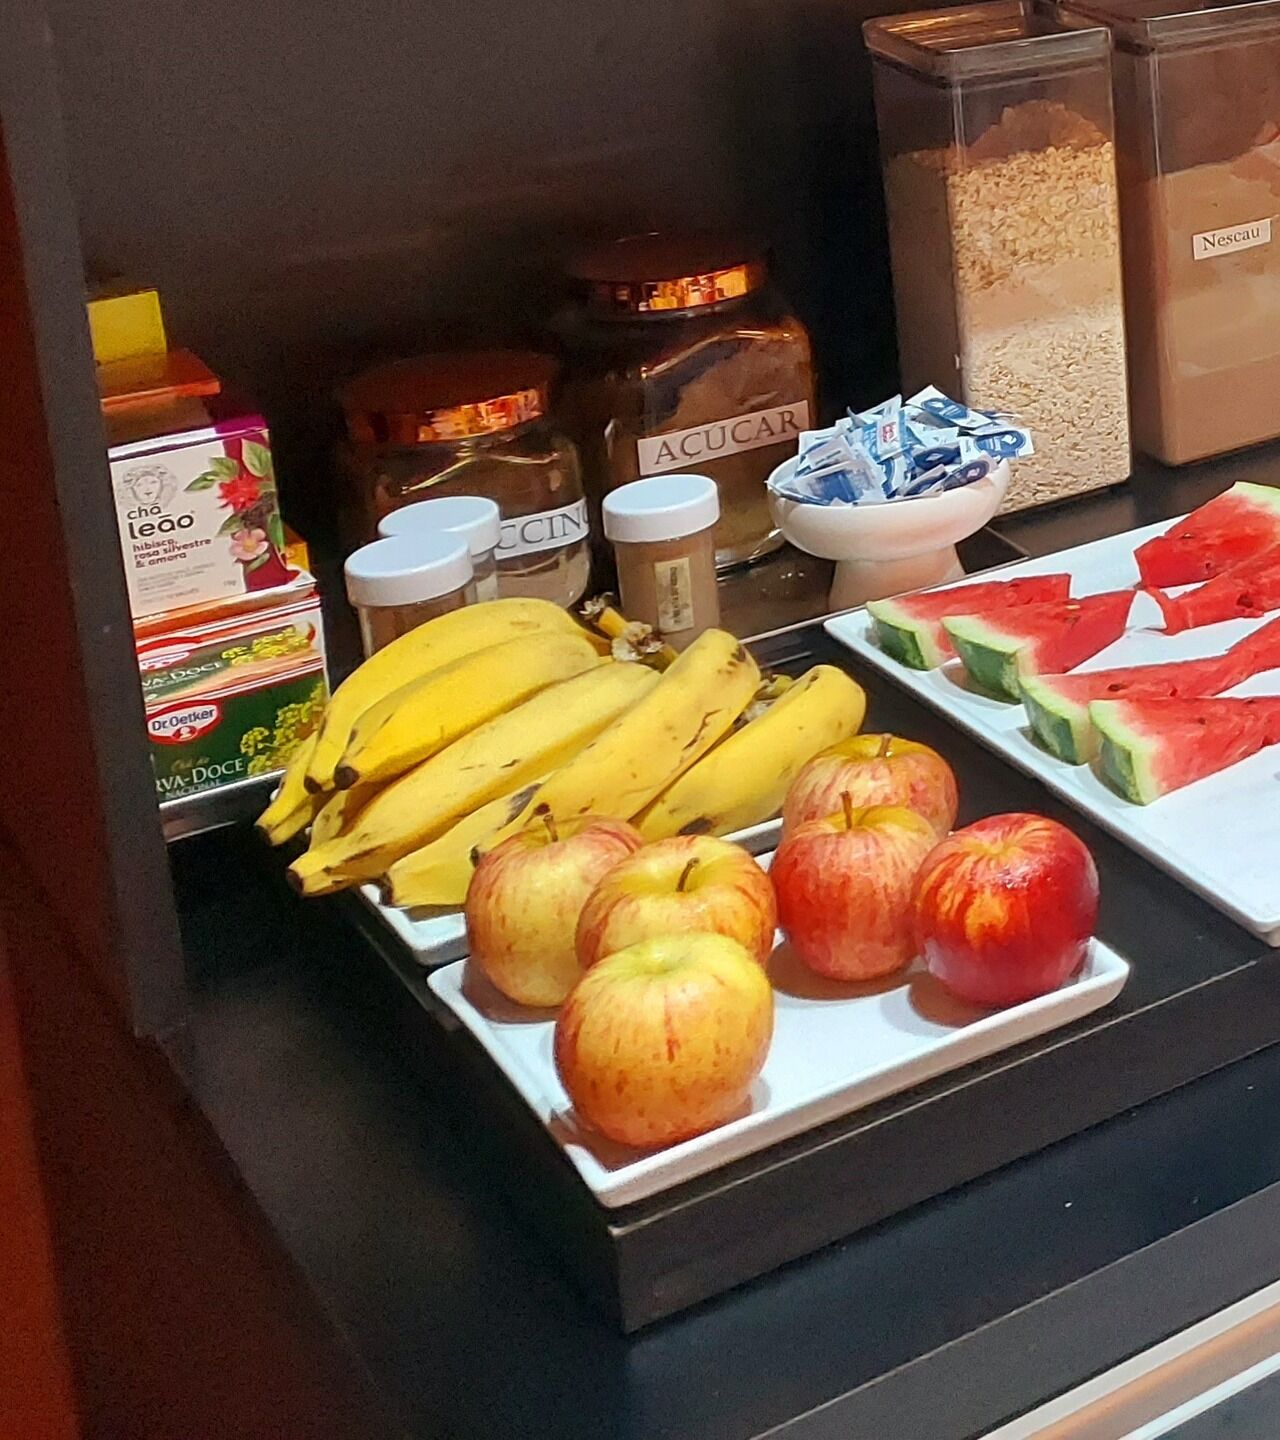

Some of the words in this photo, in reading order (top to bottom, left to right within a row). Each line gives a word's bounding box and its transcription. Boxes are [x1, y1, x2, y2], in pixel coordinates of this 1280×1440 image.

[1202, 227, 1261, 251] Nescau
[654, 410, 799, 465] AÇÚCAR
[128, 514, 194, 539] leão
[134, 549, 160, 560] rosa
[163, 539, 212, 554] silvestre
[148, 552, 187, 566] amora
